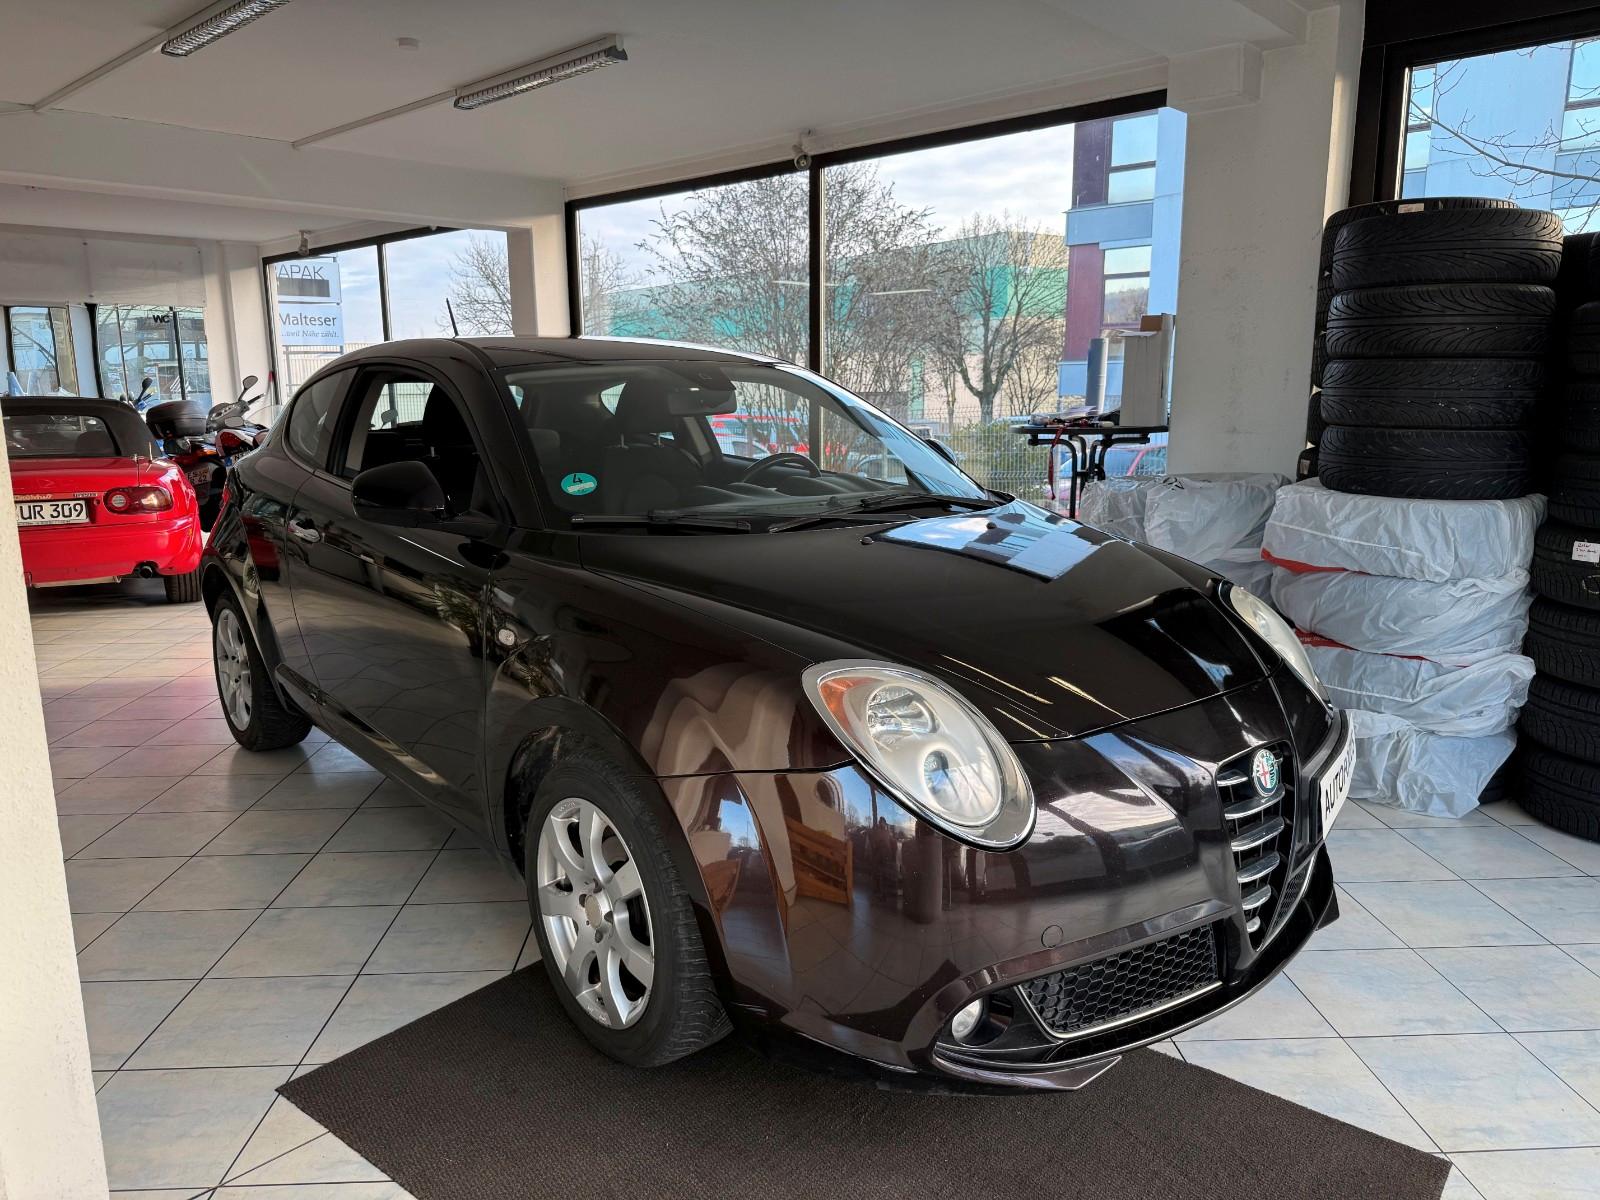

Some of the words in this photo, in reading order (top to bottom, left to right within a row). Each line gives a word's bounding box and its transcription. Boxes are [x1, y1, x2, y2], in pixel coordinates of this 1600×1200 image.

[278, 264, 325, 280] APAK
[152, 314, 170, 324] WC
[278, 312, 337, 327] Malteser
[572, 473, 583, 484] 4
[19, 504, 45, 520] UR
[49, 502, 84, 519] 309
